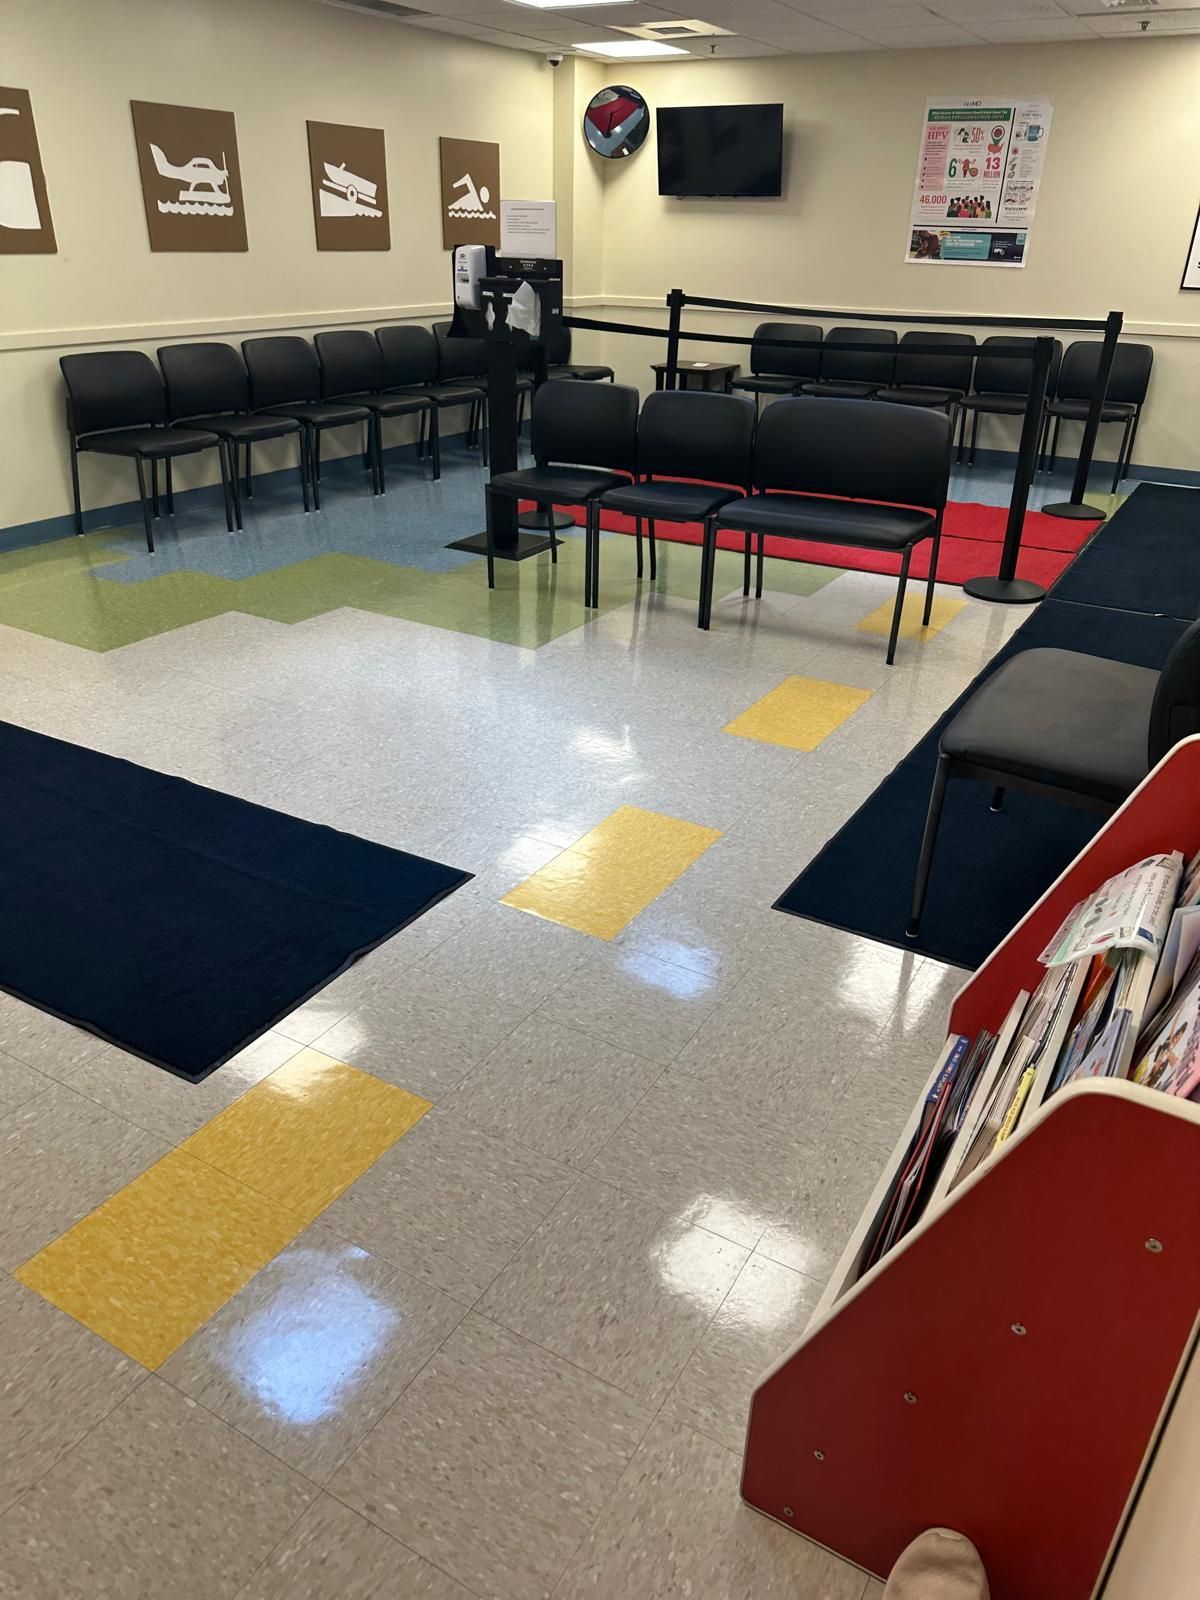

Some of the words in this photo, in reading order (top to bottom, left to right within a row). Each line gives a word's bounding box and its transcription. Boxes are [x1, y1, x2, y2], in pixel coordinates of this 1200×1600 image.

[928, 131, 949, 140] HPV
[948, 158, 957, 178] 6
[985, 157, 1001, 169] 13
[919, 195, 947, 204] 46,000
